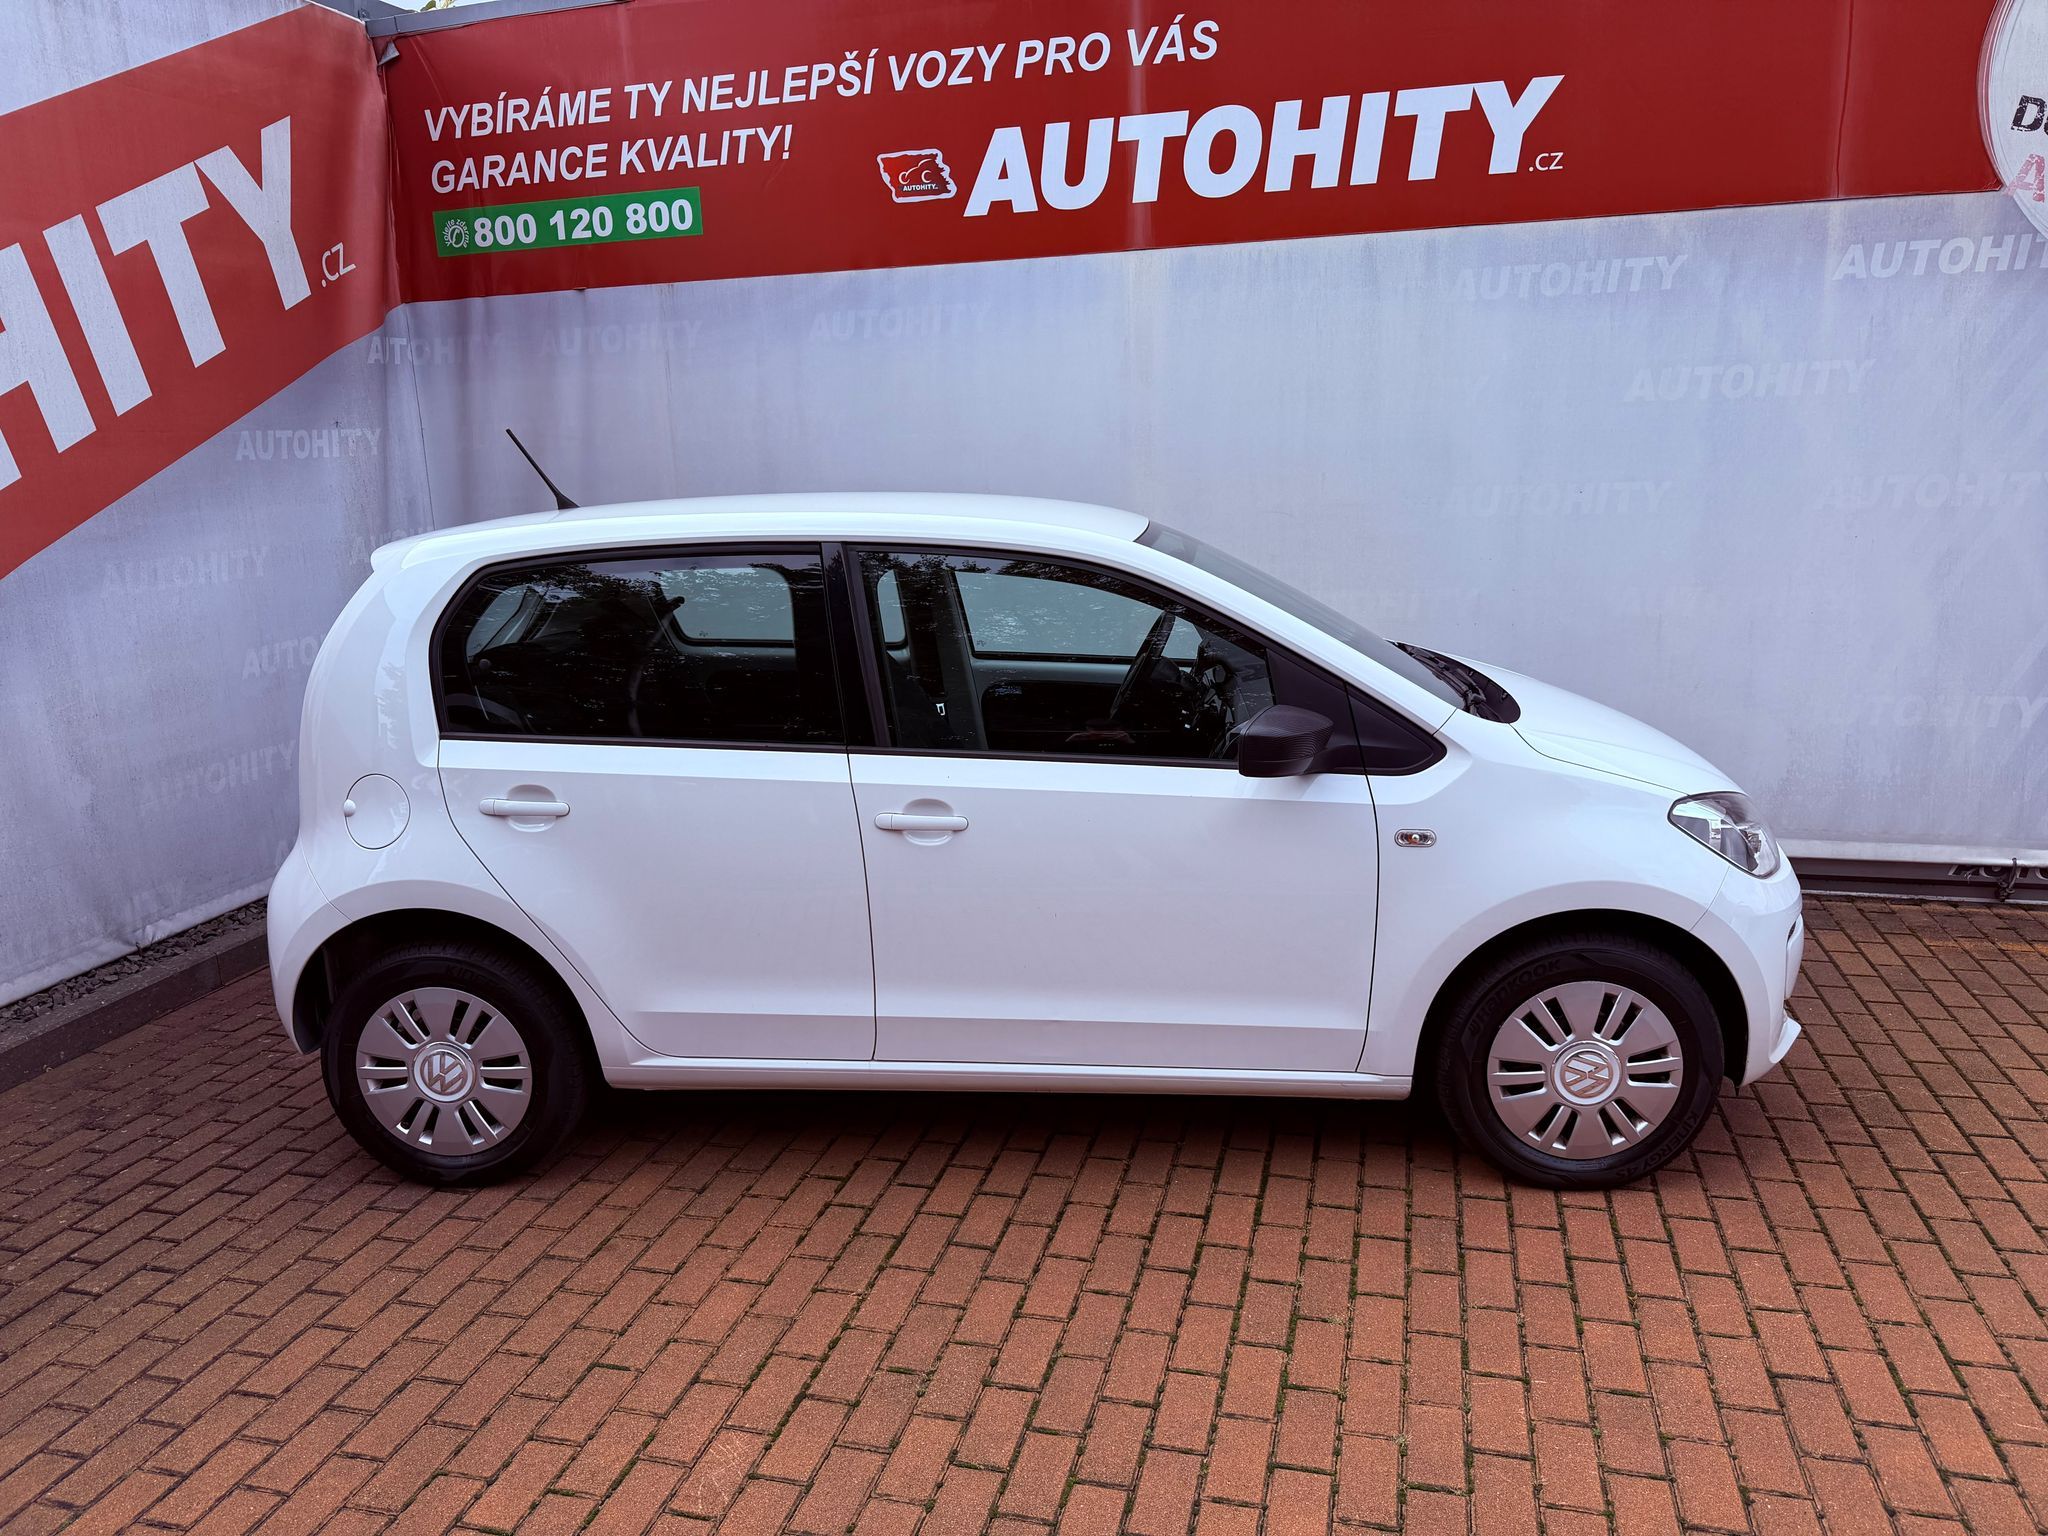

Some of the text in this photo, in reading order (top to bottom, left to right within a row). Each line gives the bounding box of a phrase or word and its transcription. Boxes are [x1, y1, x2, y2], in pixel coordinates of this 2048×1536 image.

[424, 13, 1220, 142] VYBÍRÁME TY NEJLEPŠÍ VOZY PRO VÁS
[431, 124, 793, 195] GARANCE KVALITY!
[473, 198, 693, 248] 800 120 800
[1448, 253, 1690, 302] AUTOHITY
[1623, 357, 1878, 402] AUTOHITY
[236, 428, 382, 462] AUTOHITY
